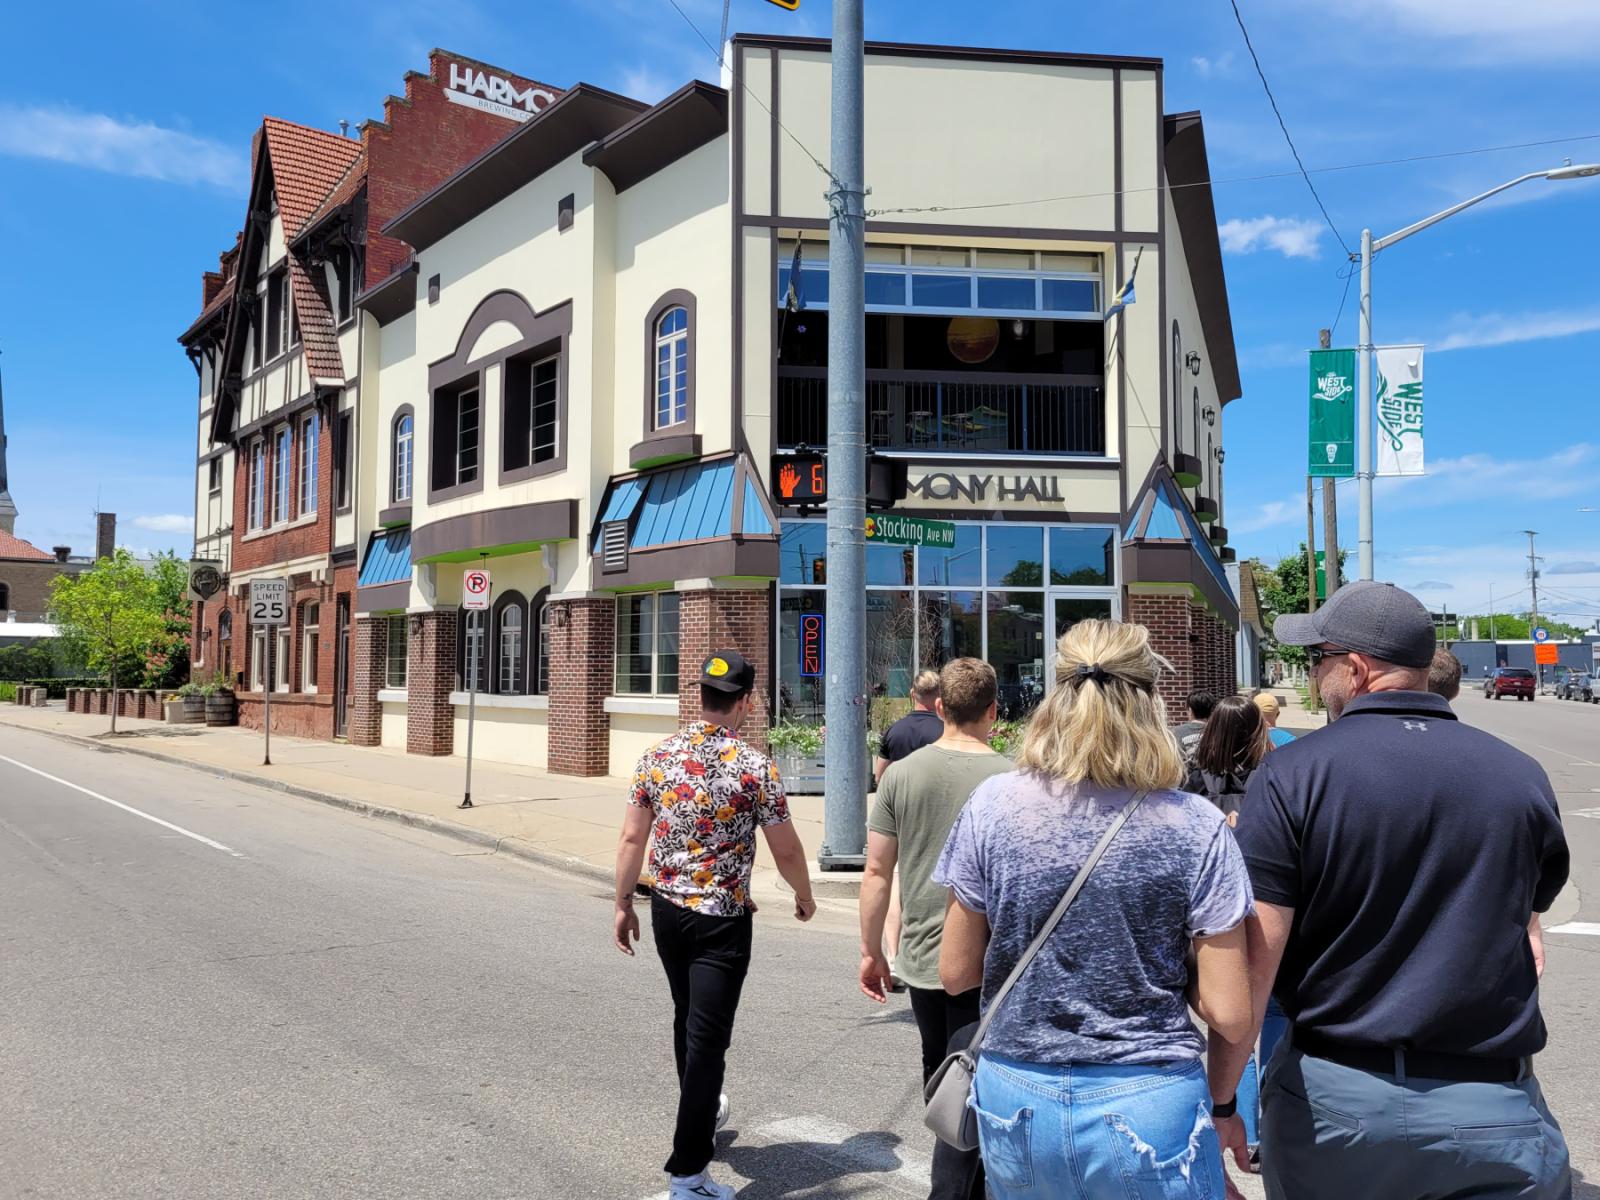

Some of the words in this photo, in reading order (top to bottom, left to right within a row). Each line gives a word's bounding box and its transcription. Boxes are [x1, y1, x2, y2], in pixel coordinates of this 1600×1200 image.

[478, 99, 517, 118] BREWING
[1317, 376, 1347, 391] WEST
[1381, 396, 1402, 429] SIDE
[1393, 381, 1423, 439] WEST
[811, 464, 823, 494] 6
[998, 475, 1065, 502] HALL
[876, 516, 923, 545] Stocking
[926, 527, 940, 542] Ave
[942, 528, 954, 543] NW
[254, 602, 284, 618] 25
[804, 617, 819, 673] OPEN
